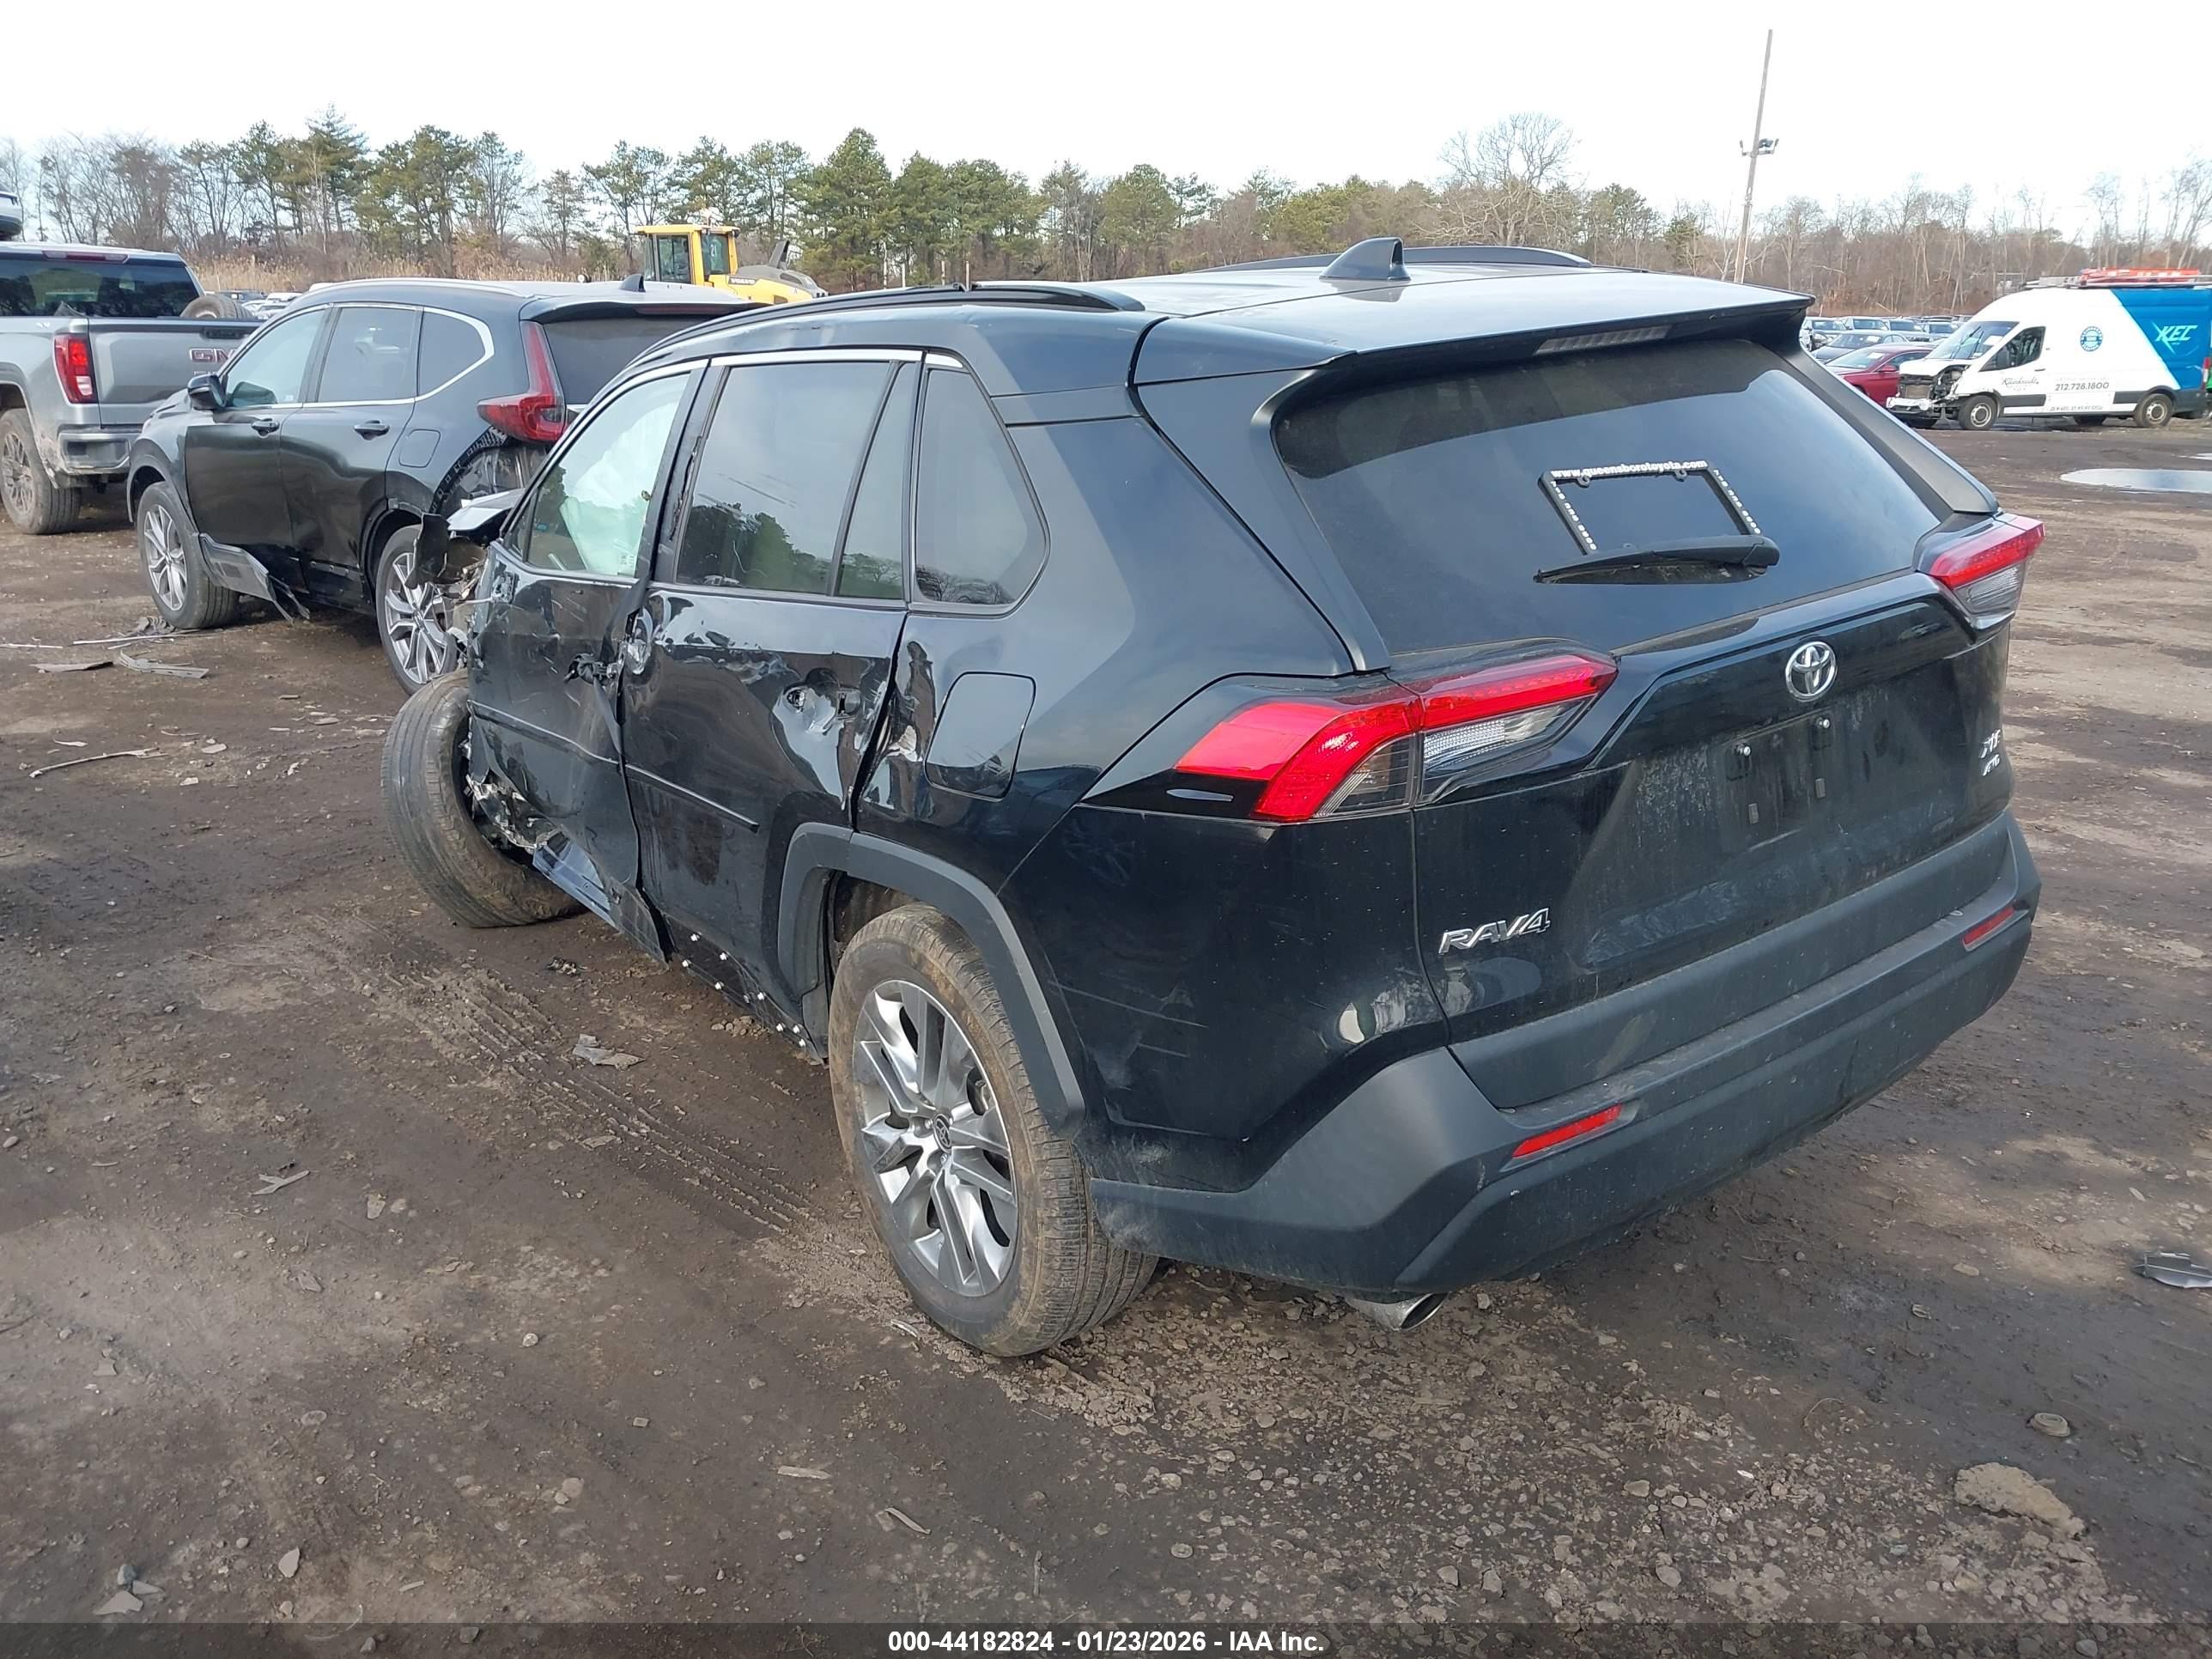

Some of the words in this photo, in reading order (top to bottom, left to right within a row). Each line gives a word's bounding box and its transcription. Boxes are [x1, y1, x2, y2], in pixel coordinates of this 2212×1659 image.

[189, 348, 237, 362] GM
[1551, 460, 1708, 477] www.queensborotoyota.com
[1438, 908, 1551, 955] RAV4
